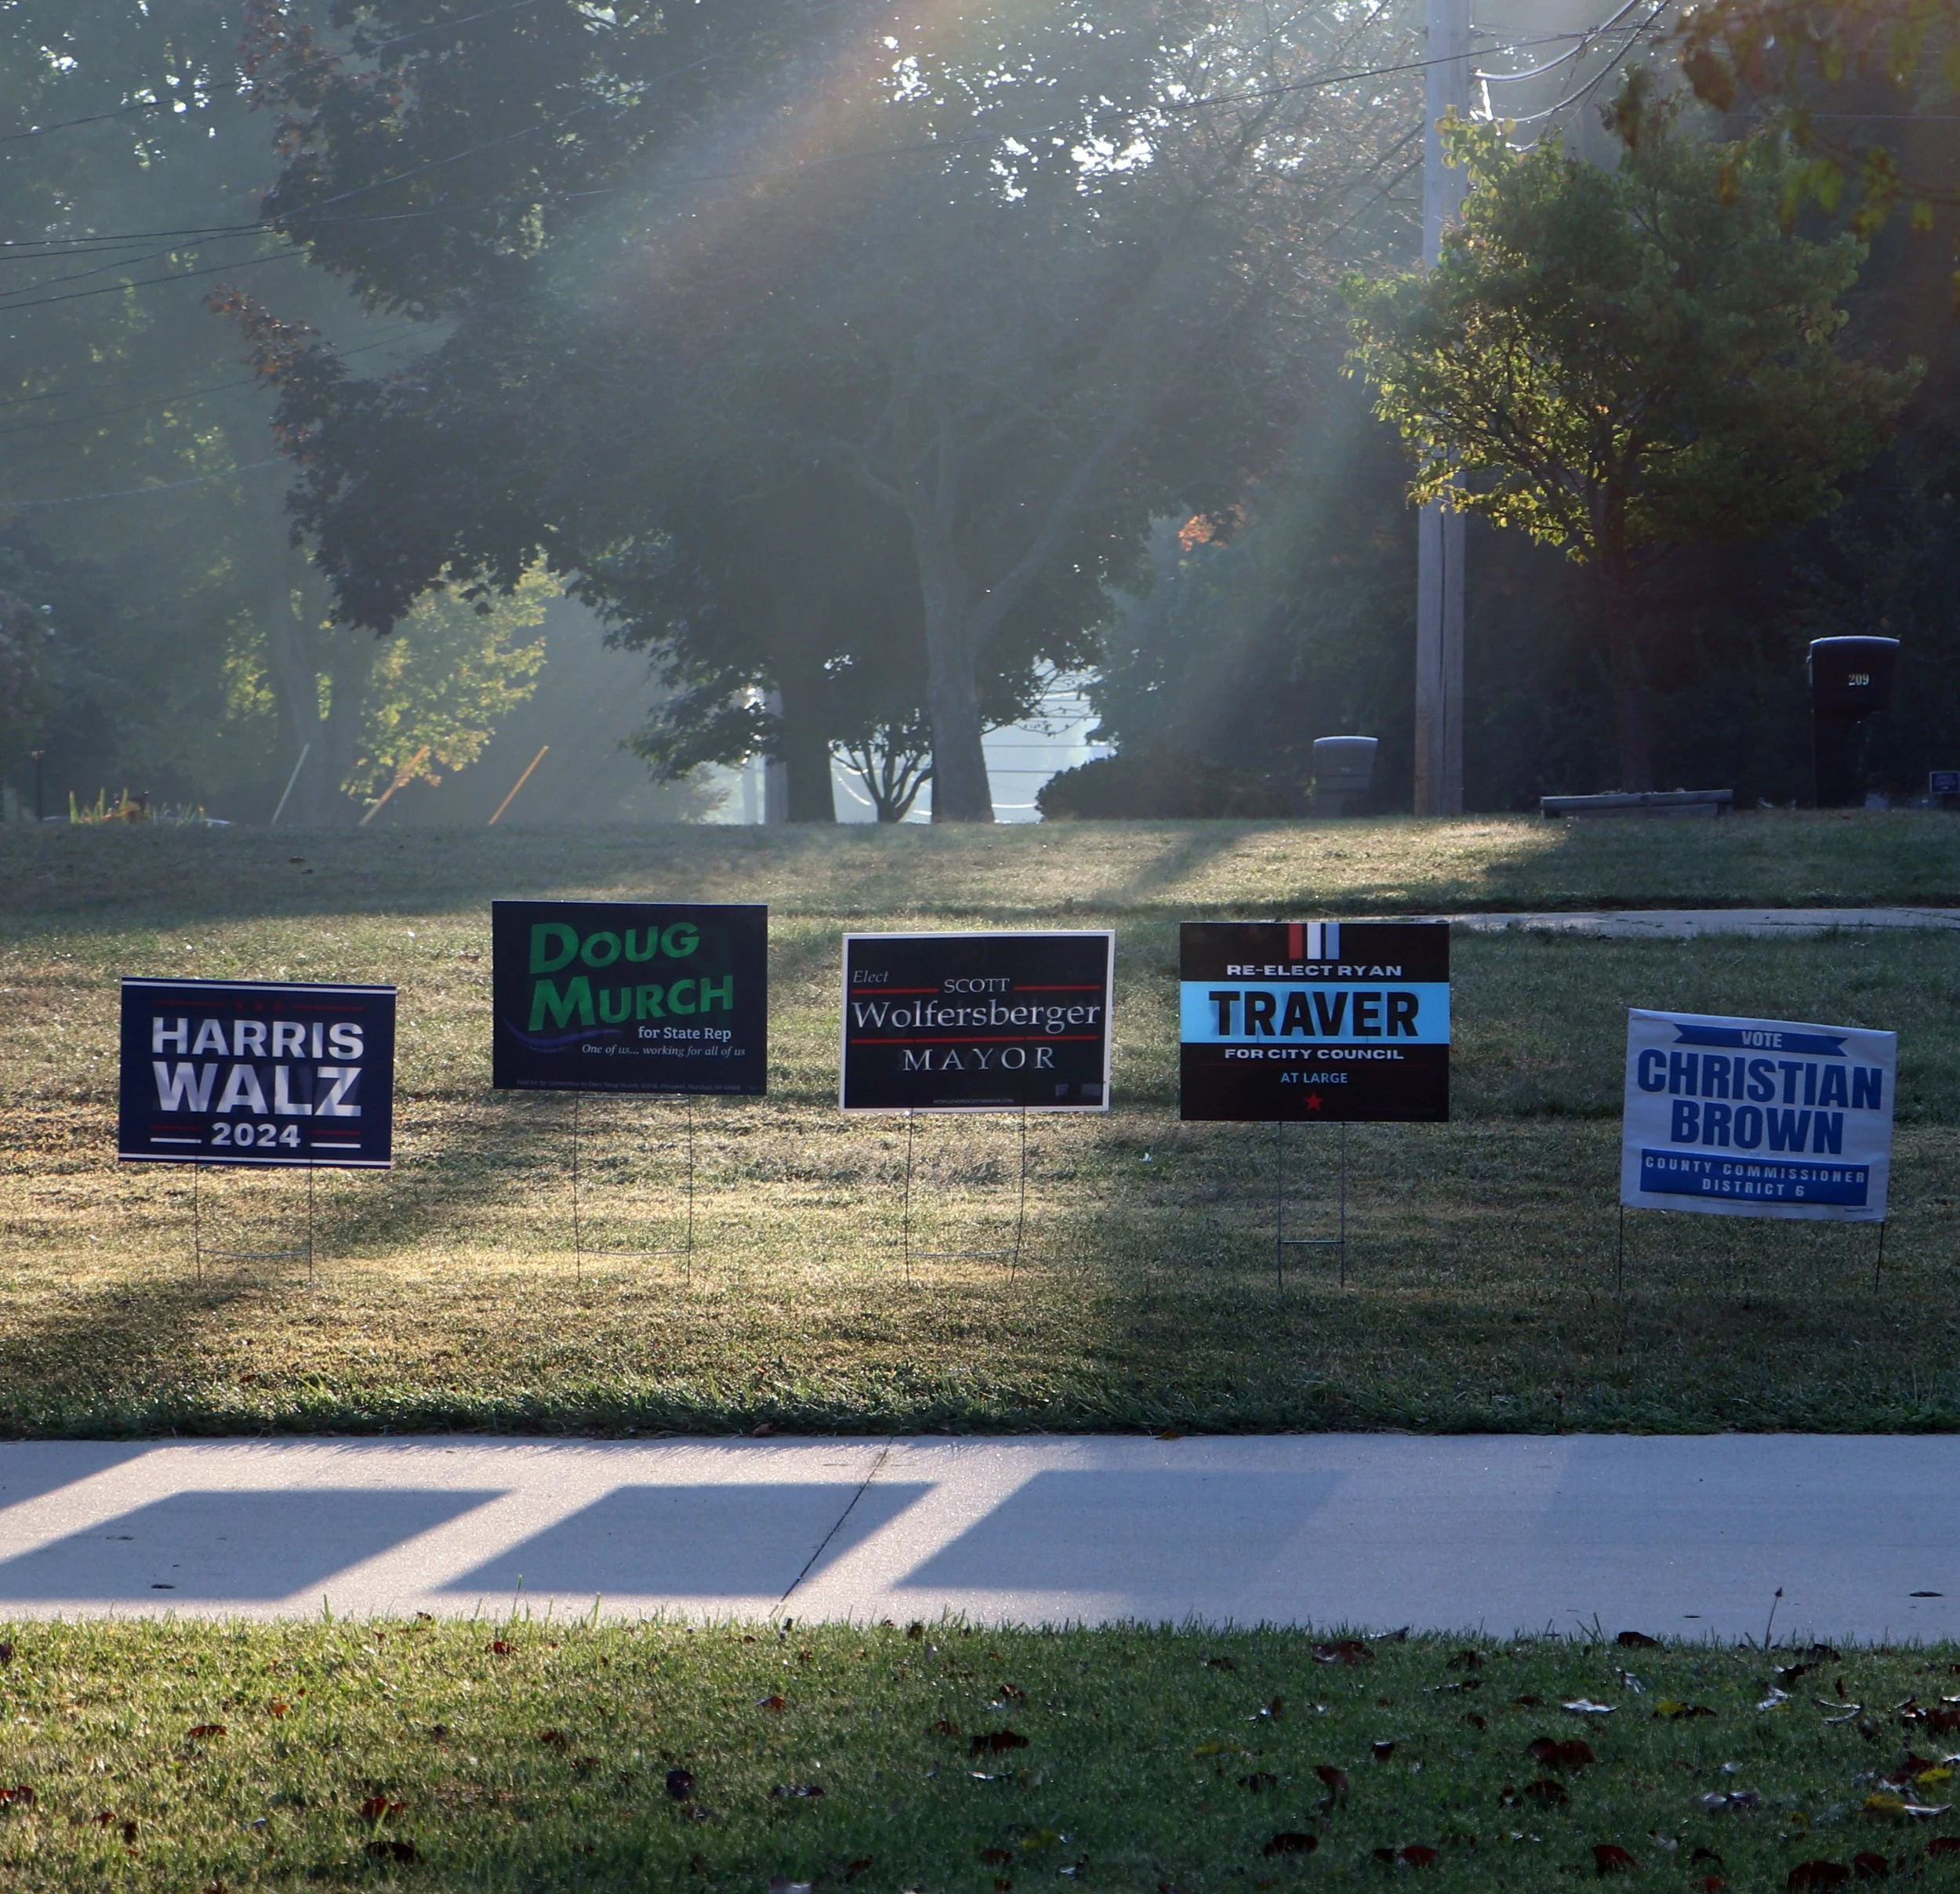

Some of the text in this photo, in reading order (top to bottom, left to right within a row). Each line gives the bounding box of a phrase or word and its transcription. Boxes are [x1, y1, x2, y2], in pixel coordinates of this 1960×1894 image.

[1848, 673, 1870, 686] 209
[852, 970, 889, 984] Elect
[1226, 965, 1402, 977] RE-ELECT RYAN
[944, 978, 1010, 994] SCOTT
[851, 999, 1101, 1035] Wolfersberger
[1208, 991, 1419, 1037] TRAVER
[151, 1017, 365, 1060] HARRIS
[638, 1026, 731, 1043] for State Rep
[1742, 1030, 1783, 1048] VOTE
[582, 1043, 603, 1054] One
[604, 1044, 617, 1056] of
[643, 1045, 684, 1057] working
[685, 1046, 703, 1058] for
[705, 1047, 718, 1056] all
[720, 1046, 732, 1058] of
[902, 1047, 1055, 1071] MAYOR
[1225, 1049, 1405, 1060] FOR CITY COUNCIL
[1280, 1072, 1348, 1084] AT LARGE
[1638, 1048, 1883, 1110] CHRISTIAN
[151, 1061, 362, 1117] WALZ
[210, 1122, 301, 1148] 2024
[1671, 1099, 1844, 1155] BROWN
[1645, 1156, 1865, 1183] COUNTY COMMISSIONER
[1702, 1178, 1806, 1197] DISTRICT 6
